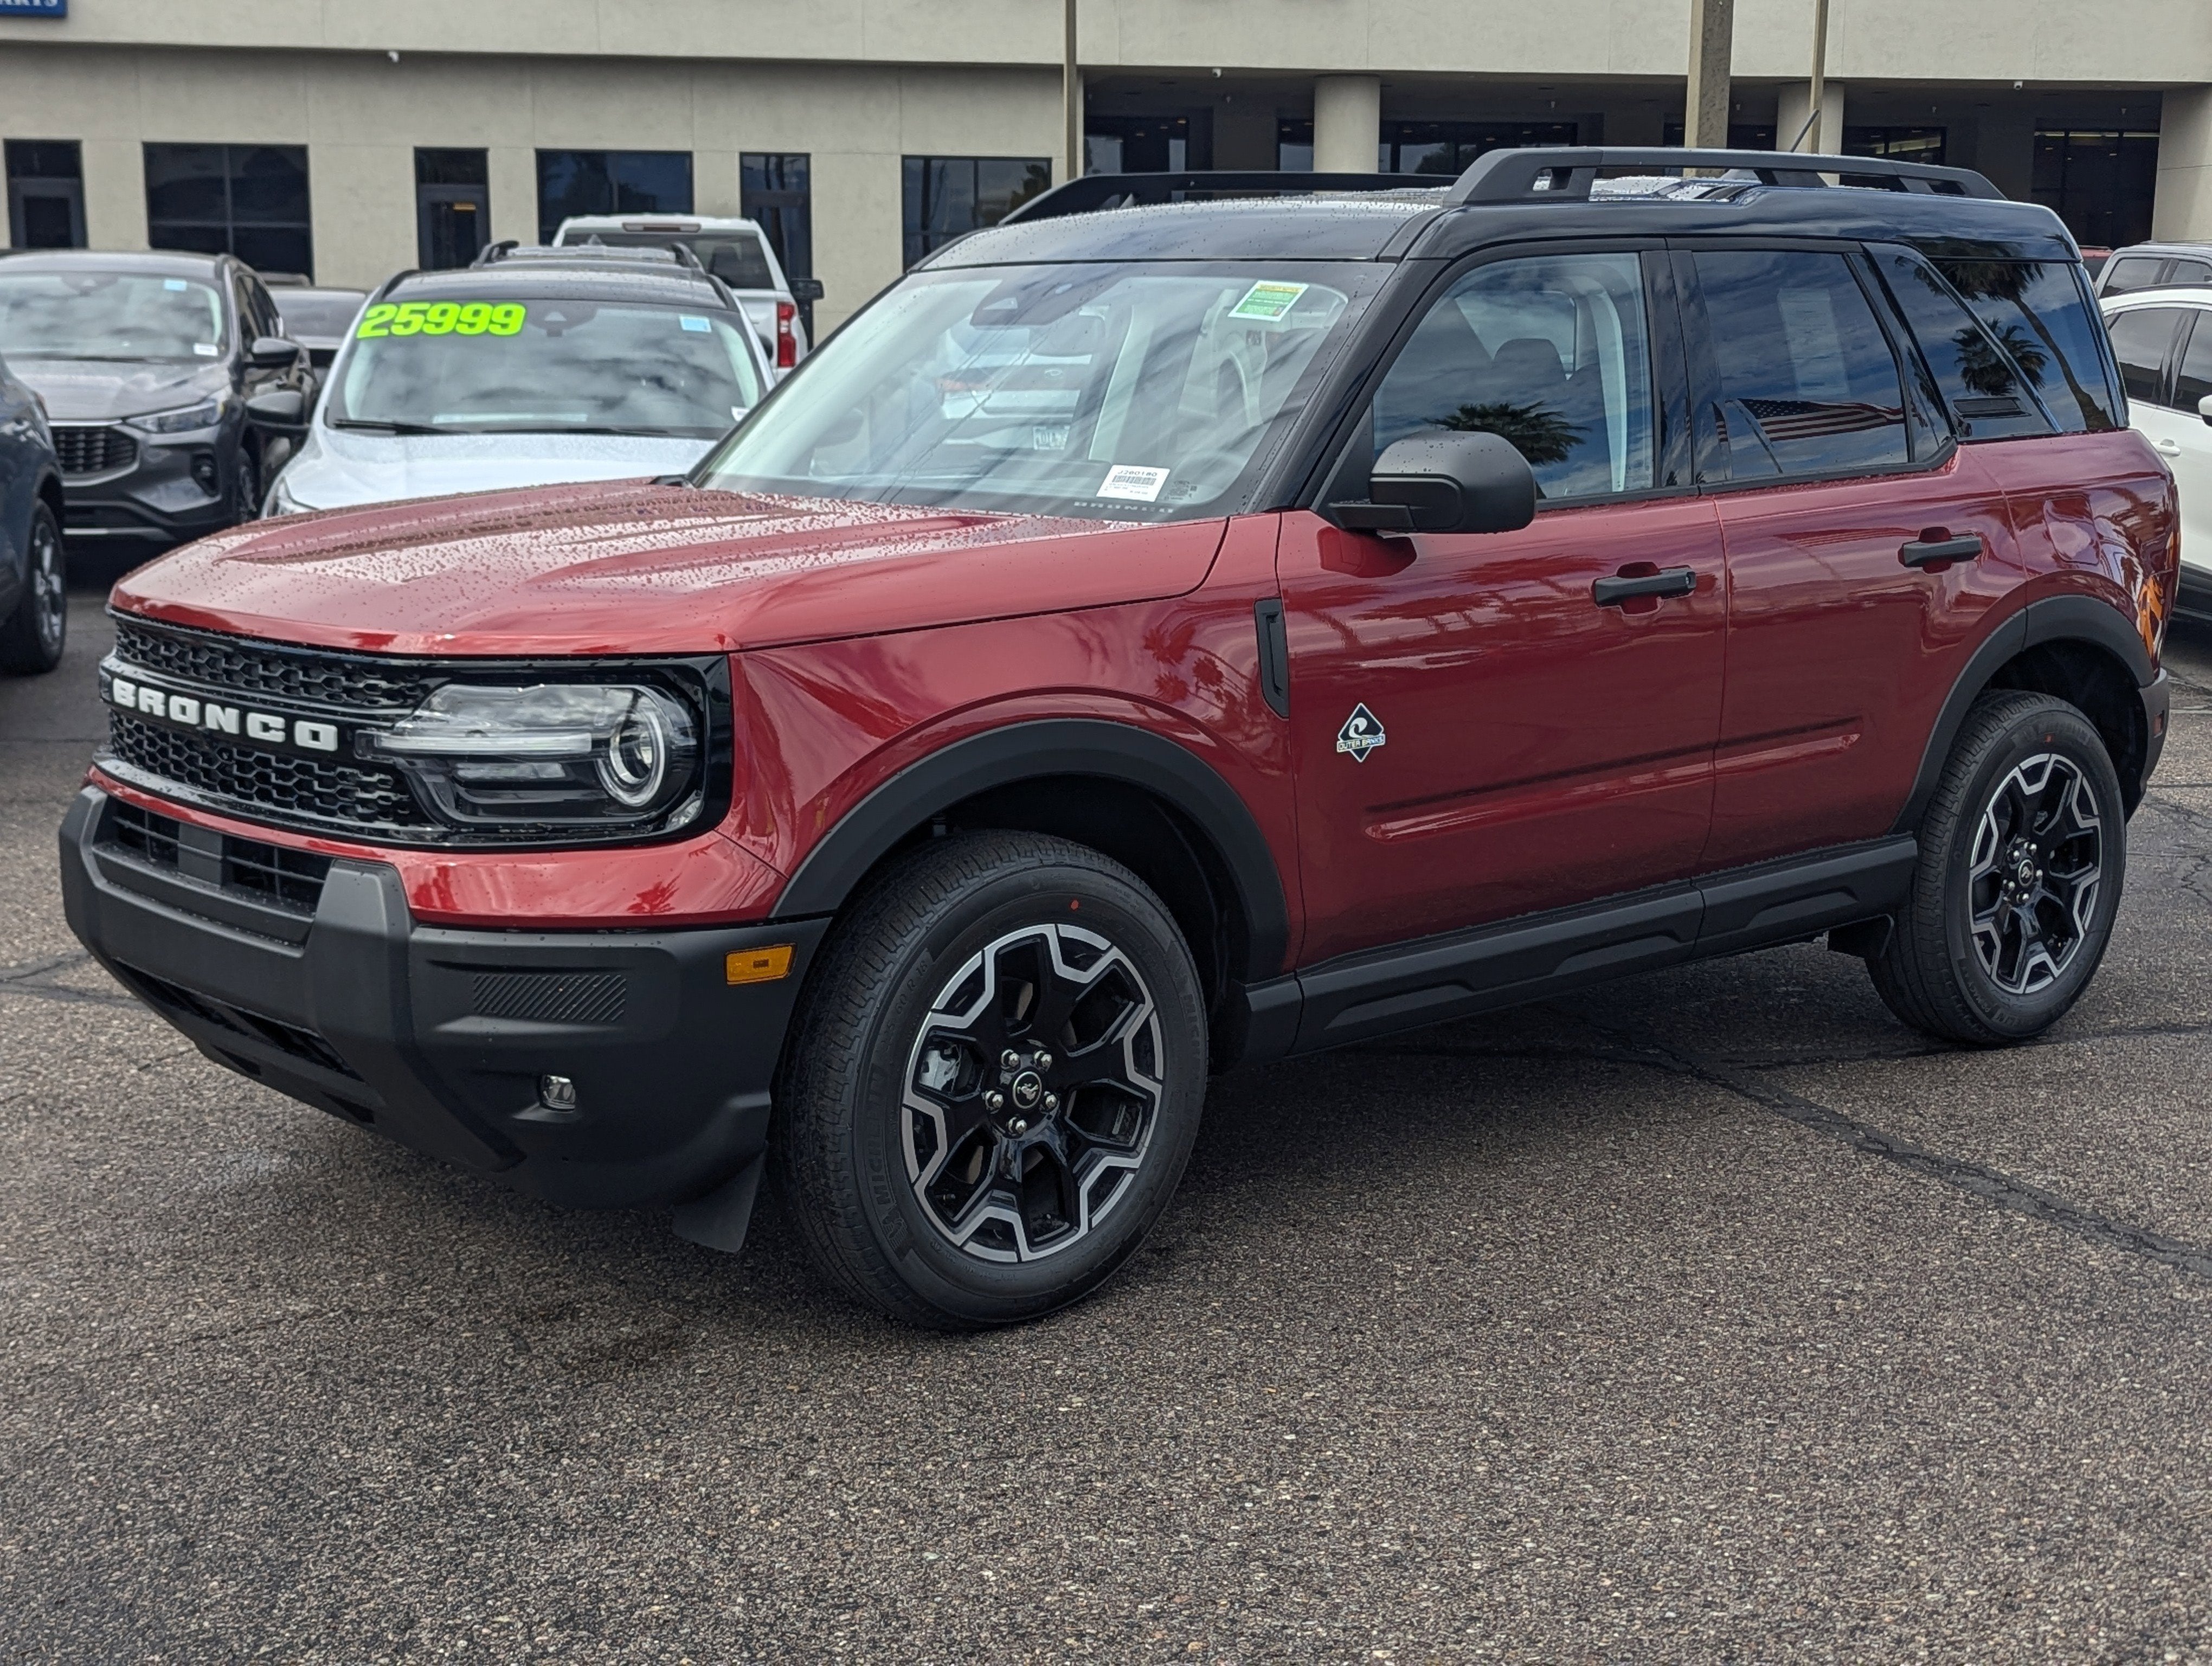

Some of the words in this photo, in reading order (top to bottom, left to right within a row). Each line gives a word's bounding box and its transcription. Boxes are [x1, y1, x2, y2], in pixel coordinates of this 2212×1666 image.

[356, 302, 526, 338] 25999
[112, 678, 338, 752] BRONCO
[1339, 739, 1361, 750] OUTER
[1362, 736, 1384, 746] BANKS
